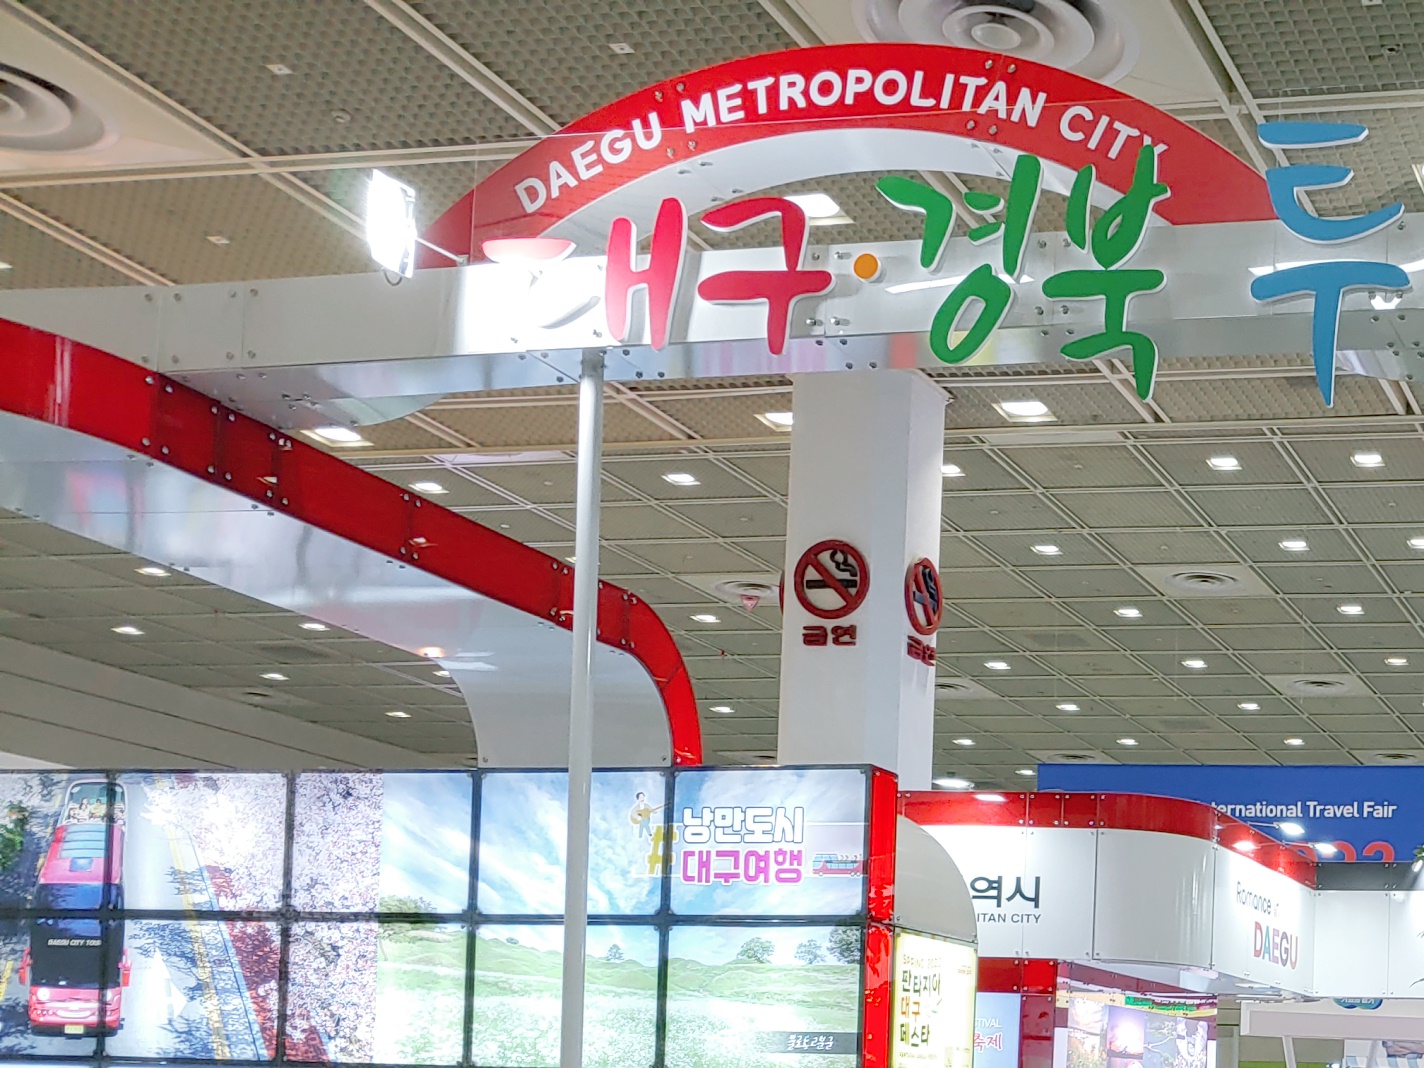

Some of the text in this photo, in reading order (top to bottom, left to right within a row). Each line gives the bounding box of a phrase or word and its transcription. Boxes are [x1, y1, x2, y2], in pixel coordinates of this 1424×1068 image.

[514, 69, 1170, 214] DAEGU METROPOLITAN CITY
[802, 625, 856, 646] 금연
[682, 806, 804, 844] 낭만도시
[1211, 801, 1398, 818] ternational Travel Fair
[680, 849, 803, 885] 대구여행
[1011, 913, 1041, 923] CITY
[1253, 920, 1298, 970] DAEGU
